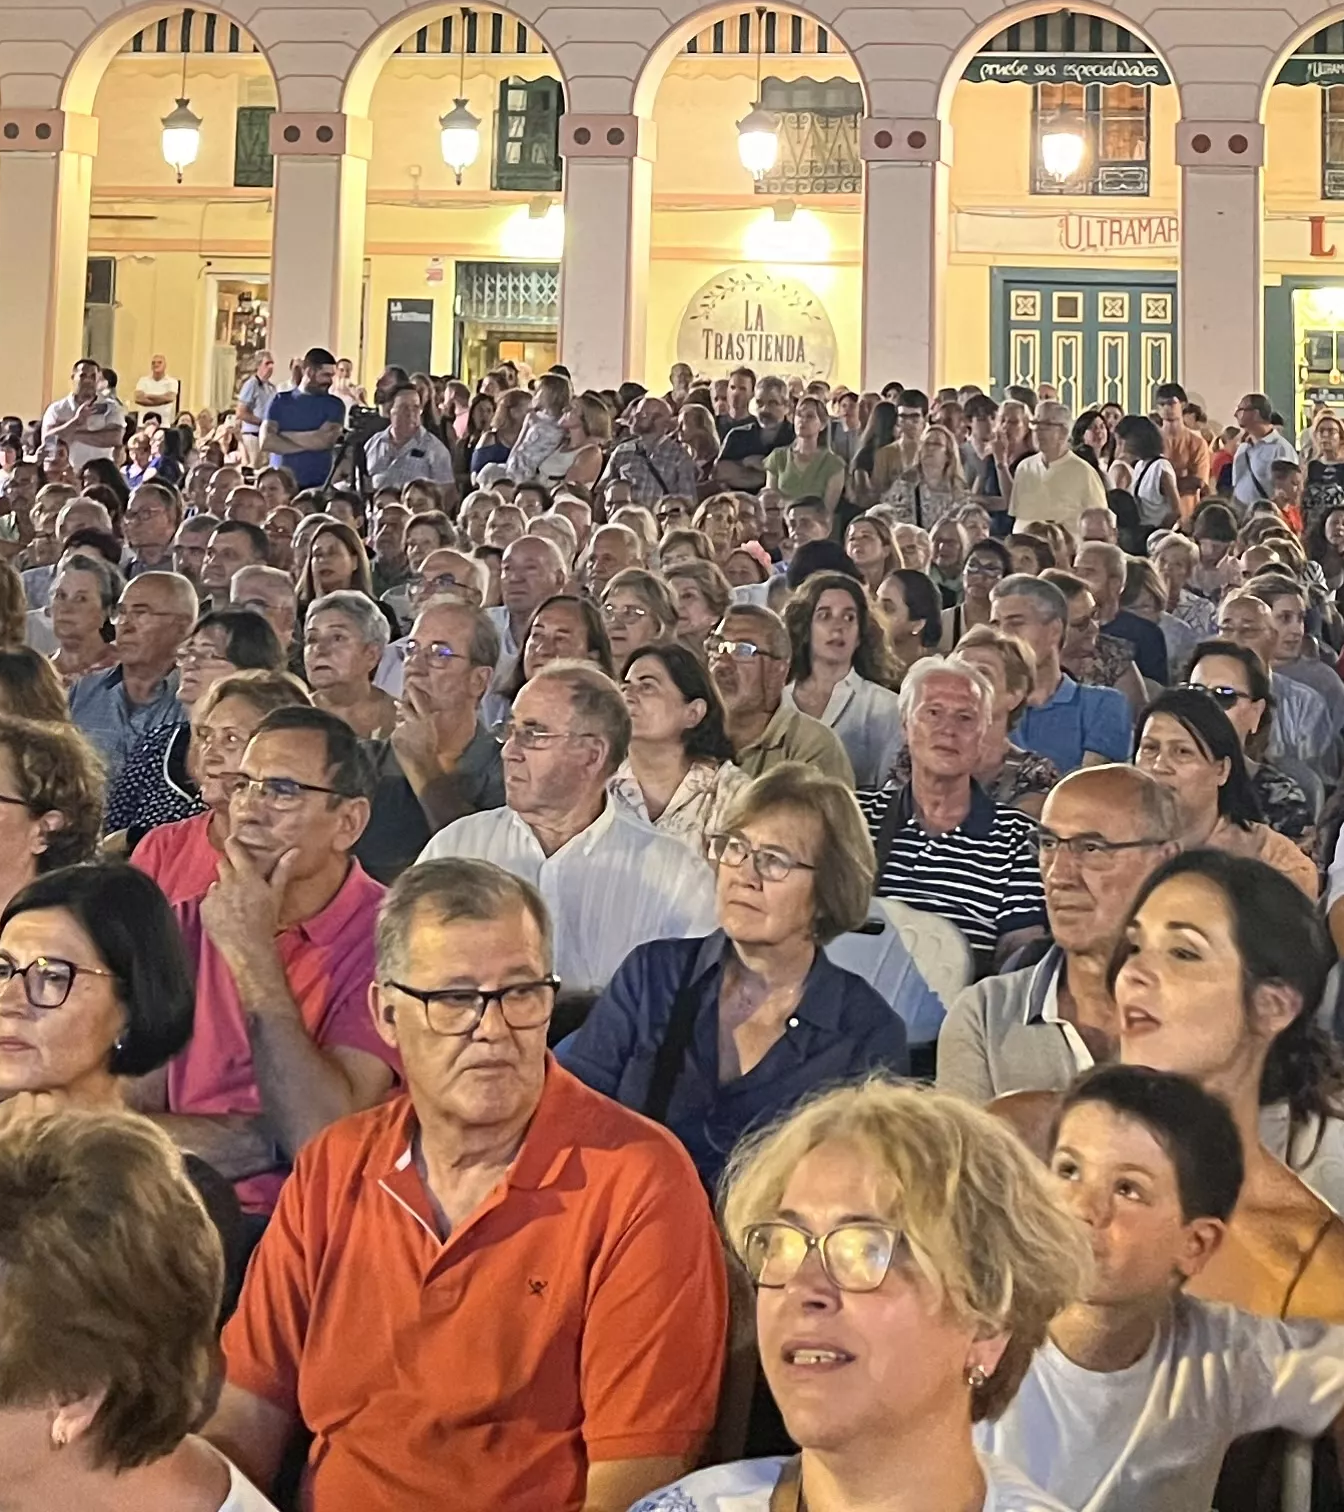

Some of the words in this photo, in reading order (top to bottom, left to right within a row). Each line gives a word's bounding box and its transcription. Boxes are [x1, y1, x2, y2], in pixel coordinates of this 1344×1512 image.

[979, 59, 1028, 80] pruebe
[1033, 63, 1057, 76] sus
[1063, 59, 1159, 81] especialidades
[744, 299, 765, 332] LA
[702, 328, 806, 363] TRASTIENDA
